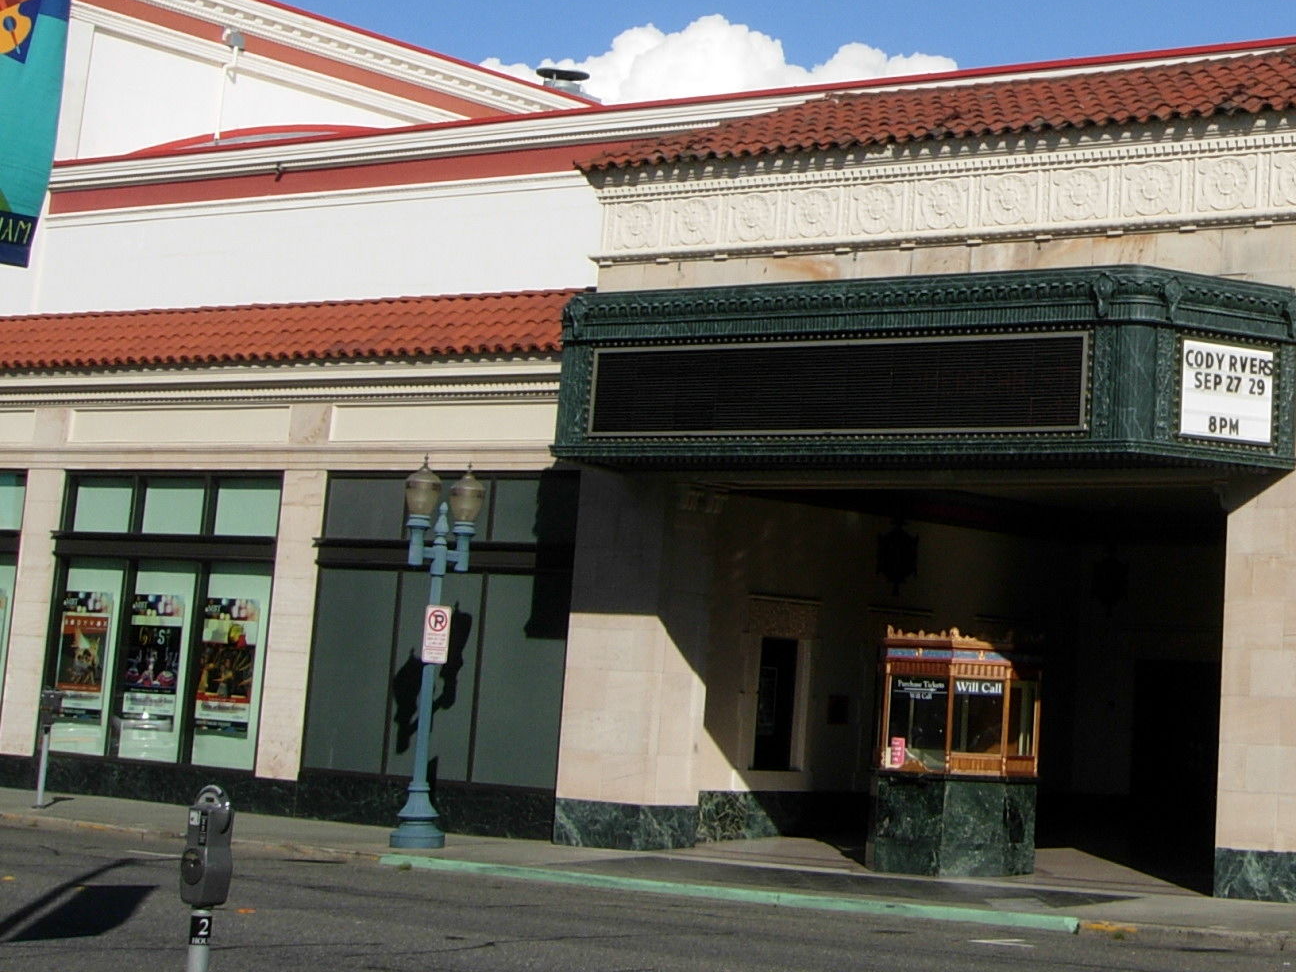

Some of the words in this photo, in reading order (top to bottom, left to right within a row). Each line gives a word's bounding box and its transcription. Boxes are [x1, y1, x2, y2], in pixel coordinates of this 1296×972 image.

[1185, 349, 1224, 370] CODY
[1229, 354, 1273, 376] RVERS
[1194, 371, 1222, 390] SEP
[1226, 375, 1242, 393] 27
[1248, 377, 1265, 395] 29
[1208, 415, 1239, 435] 8PM
[956, 681, 980, 693] Will
[981, 683, 1002, 694] Call
[197, 918, 209, 936] 2
